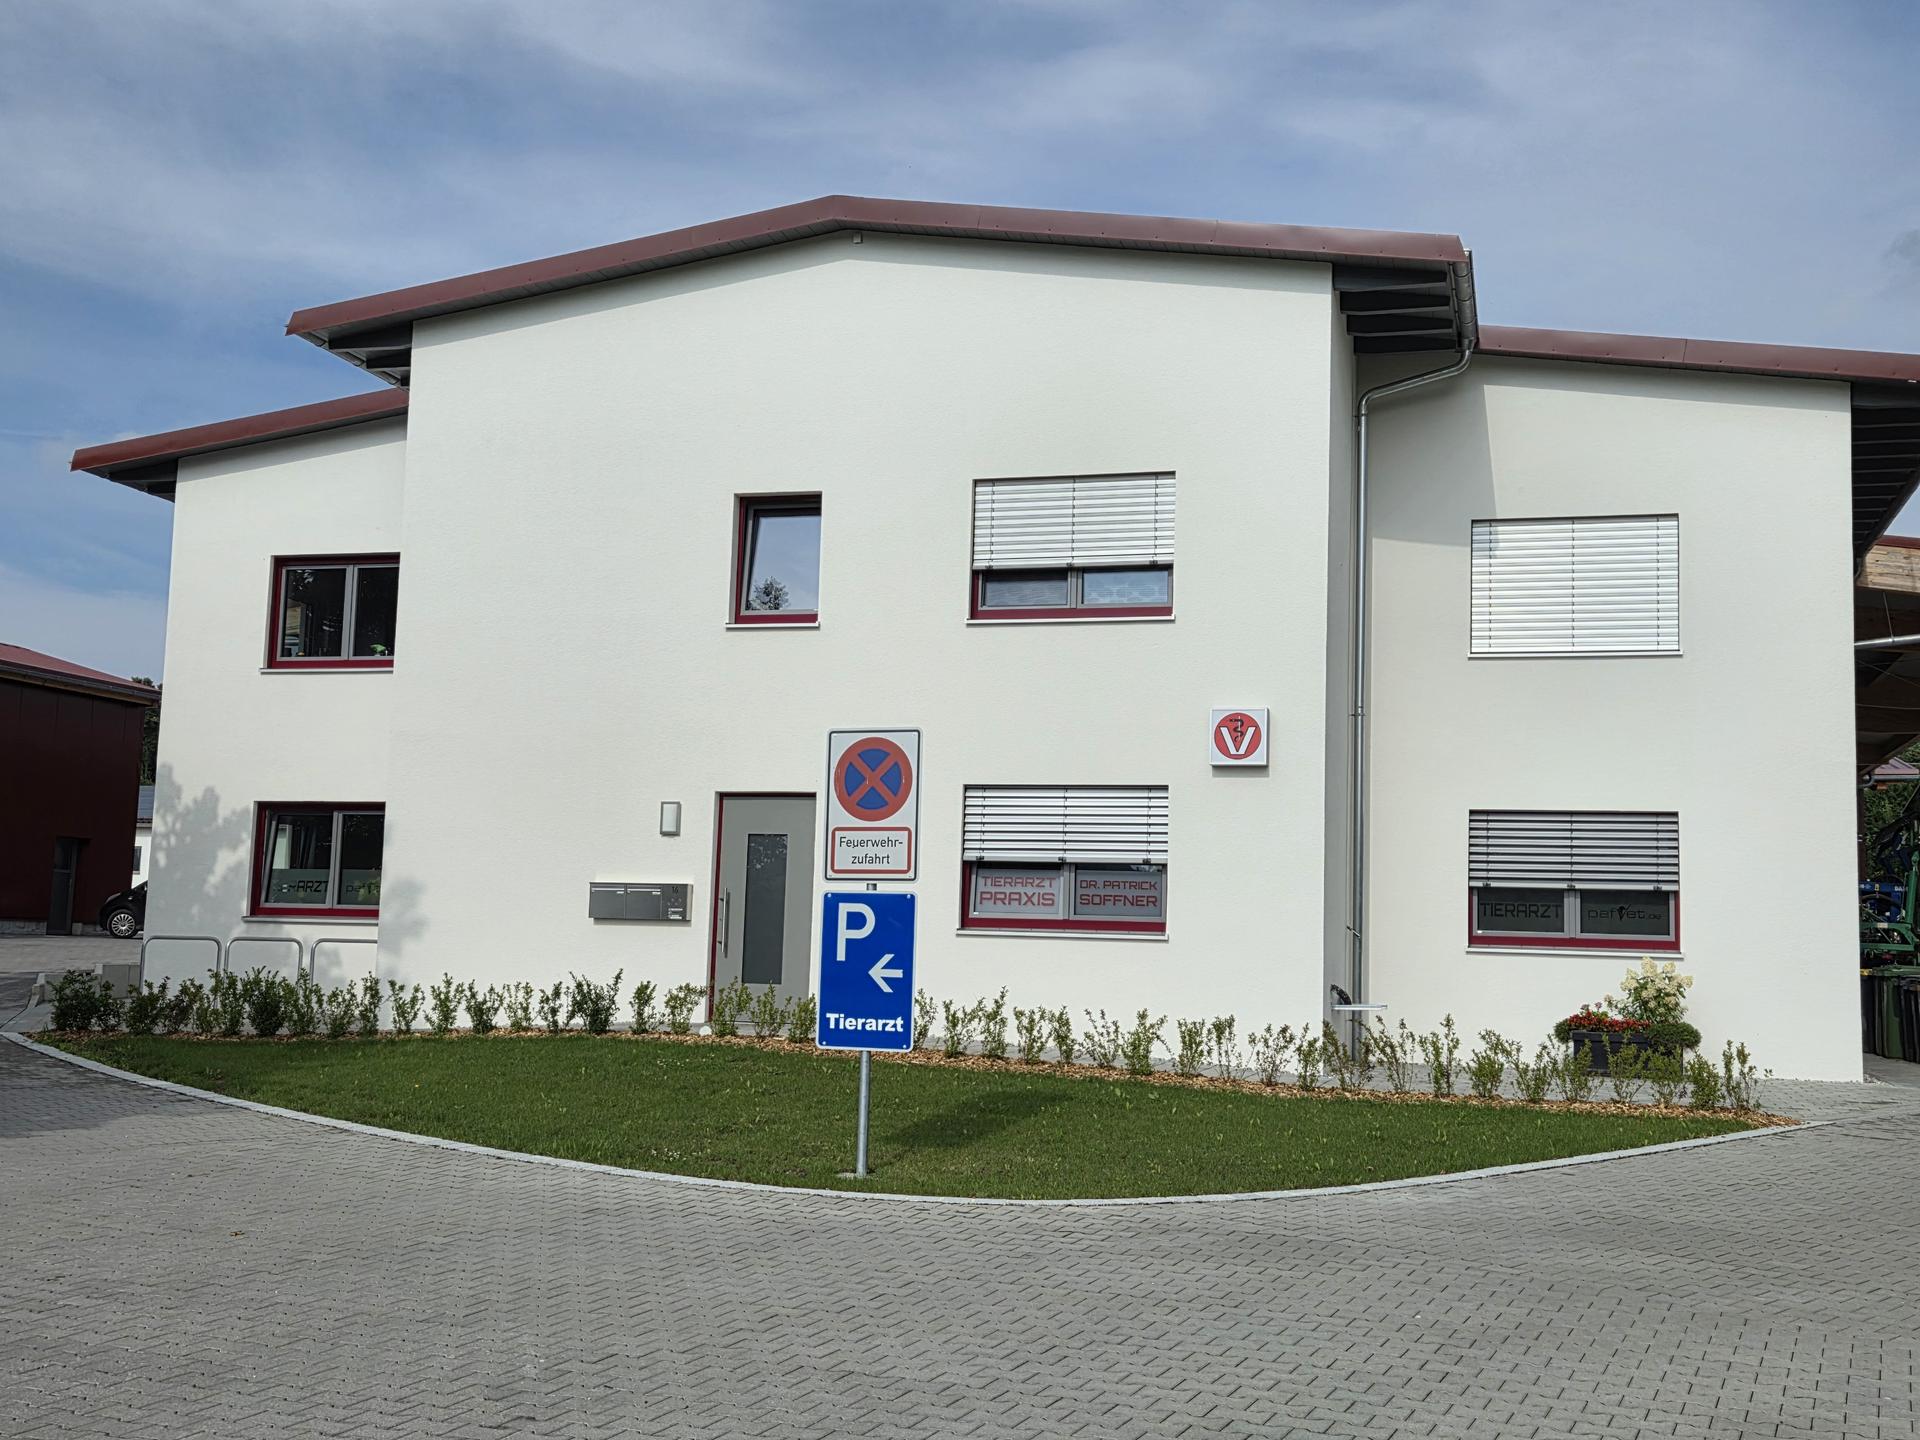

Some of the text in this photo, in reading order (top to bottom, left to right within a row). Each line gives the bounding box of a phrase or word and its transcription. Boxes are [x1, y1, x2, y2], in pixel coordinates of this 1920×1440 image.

[839, 836, 903, 848] Feuerwehr-
[851, 853, 890, 864] zufahrt
[982, 876, 1056, 888] TIERARZT
[1079, 879, 1158, 891] DR. PATRICK
[979, 891, 1055, 906] PRAXIS
[1079, 894, 1158, 907] SOFFNER
[1480, 902, 1563, 918] TIERARZT
[836, 902, 876, 962] P
[825, 1012, 904, 1033] Tierarzt
